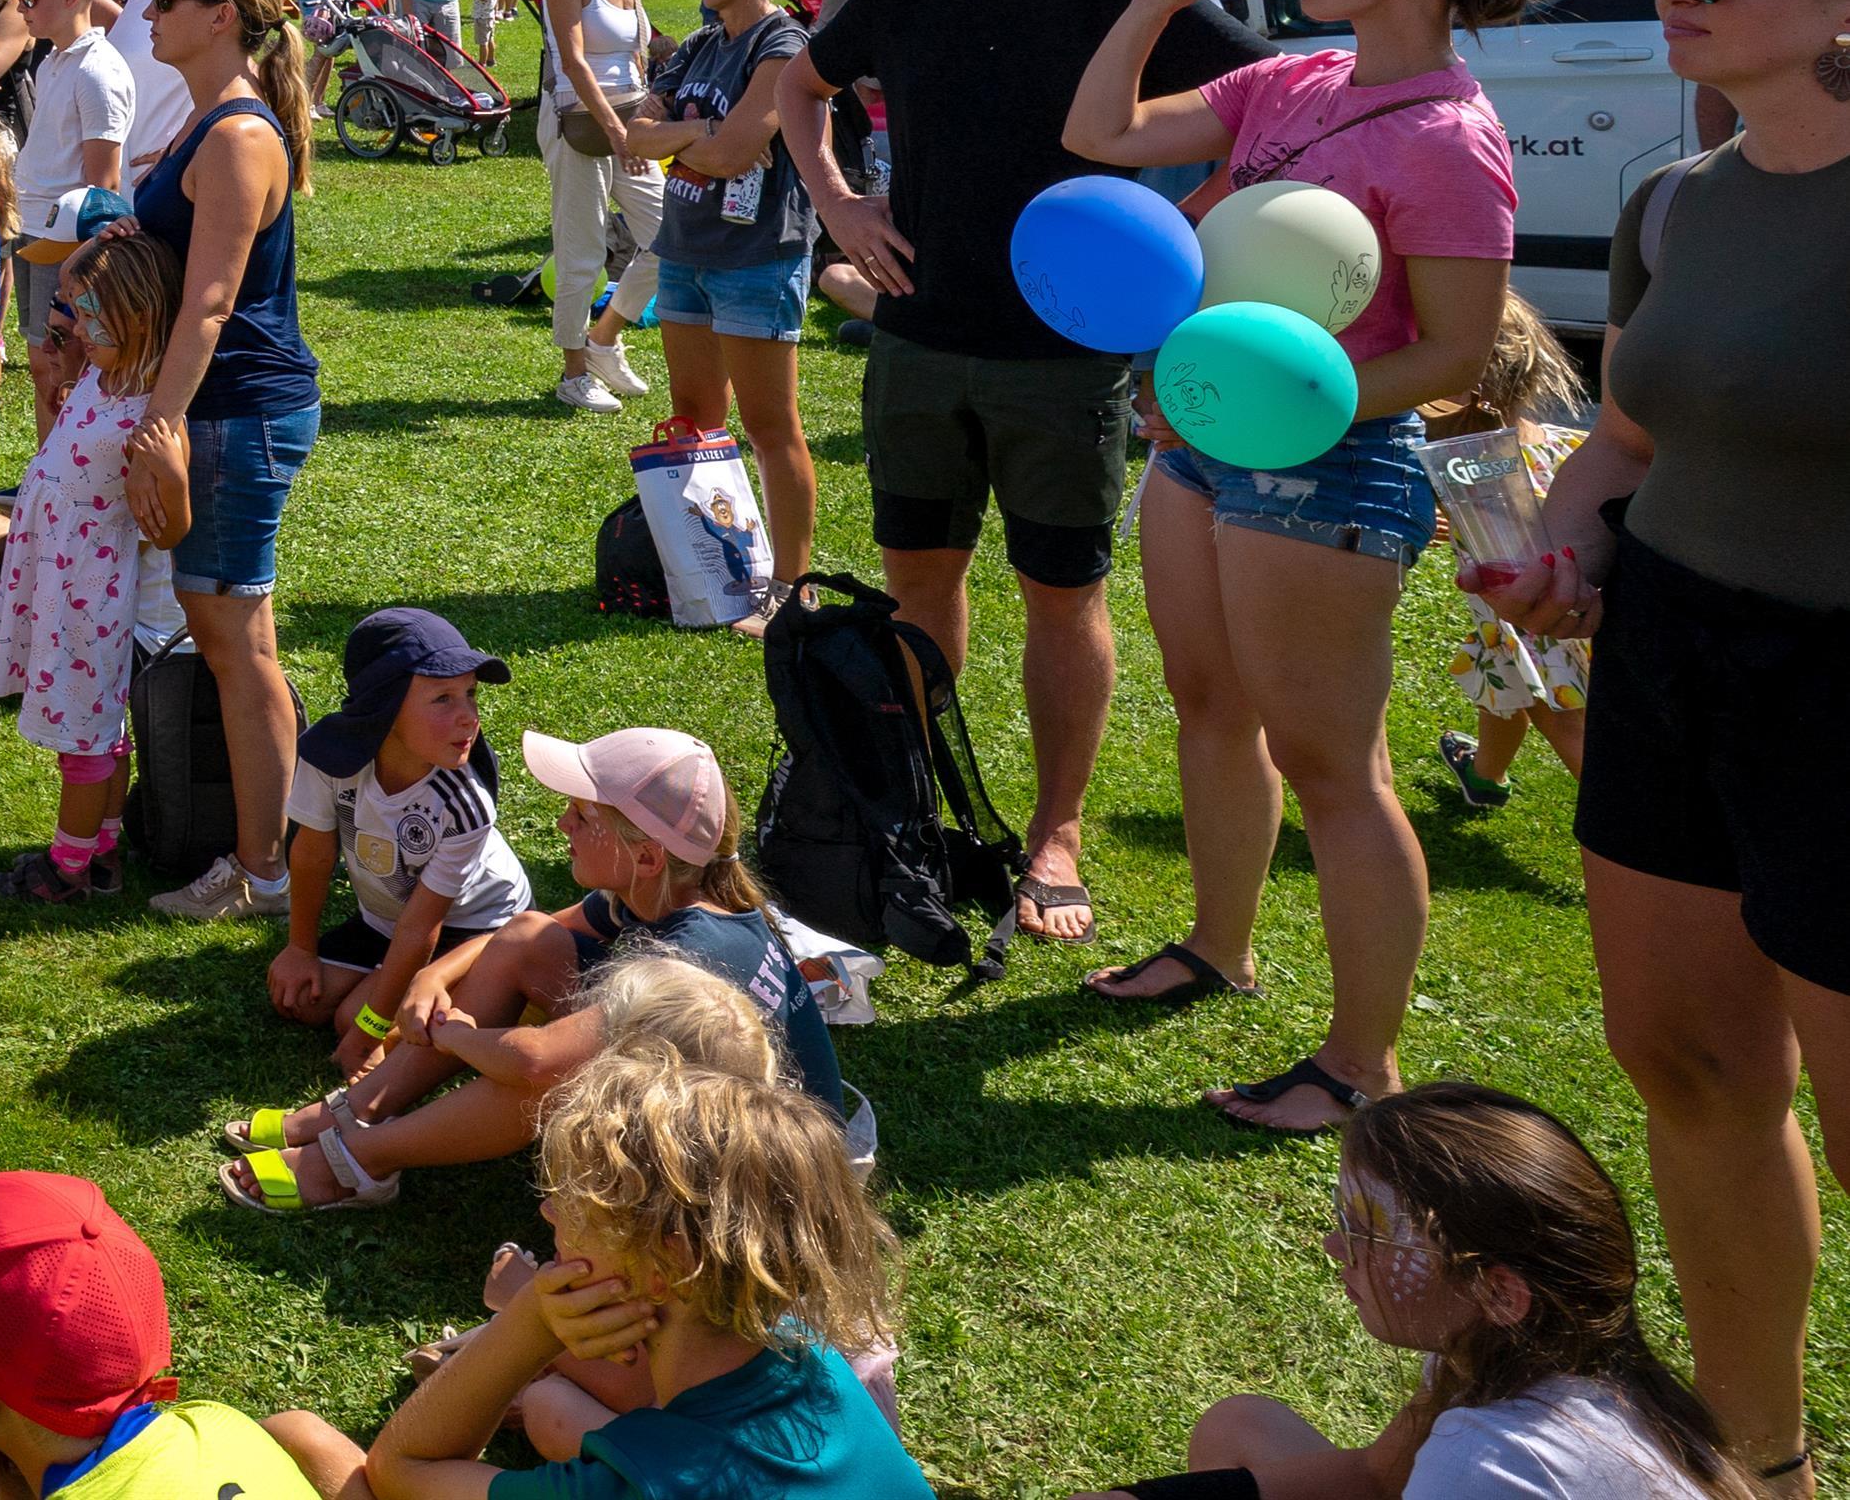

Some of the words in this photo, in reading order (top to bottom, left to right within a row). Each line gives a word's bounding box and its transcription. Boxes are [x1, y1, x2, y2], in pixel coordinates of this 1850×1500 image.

[676, 82, 711, 100] OW
[711, 86, 730, 117] TO
[667, 176, 704, 203] ARTH
[687, 450, 725, 461] POLIZEI
[1447, 457, 1519, 485] Gösser
[749, 941, 790, 1010] ET'S
